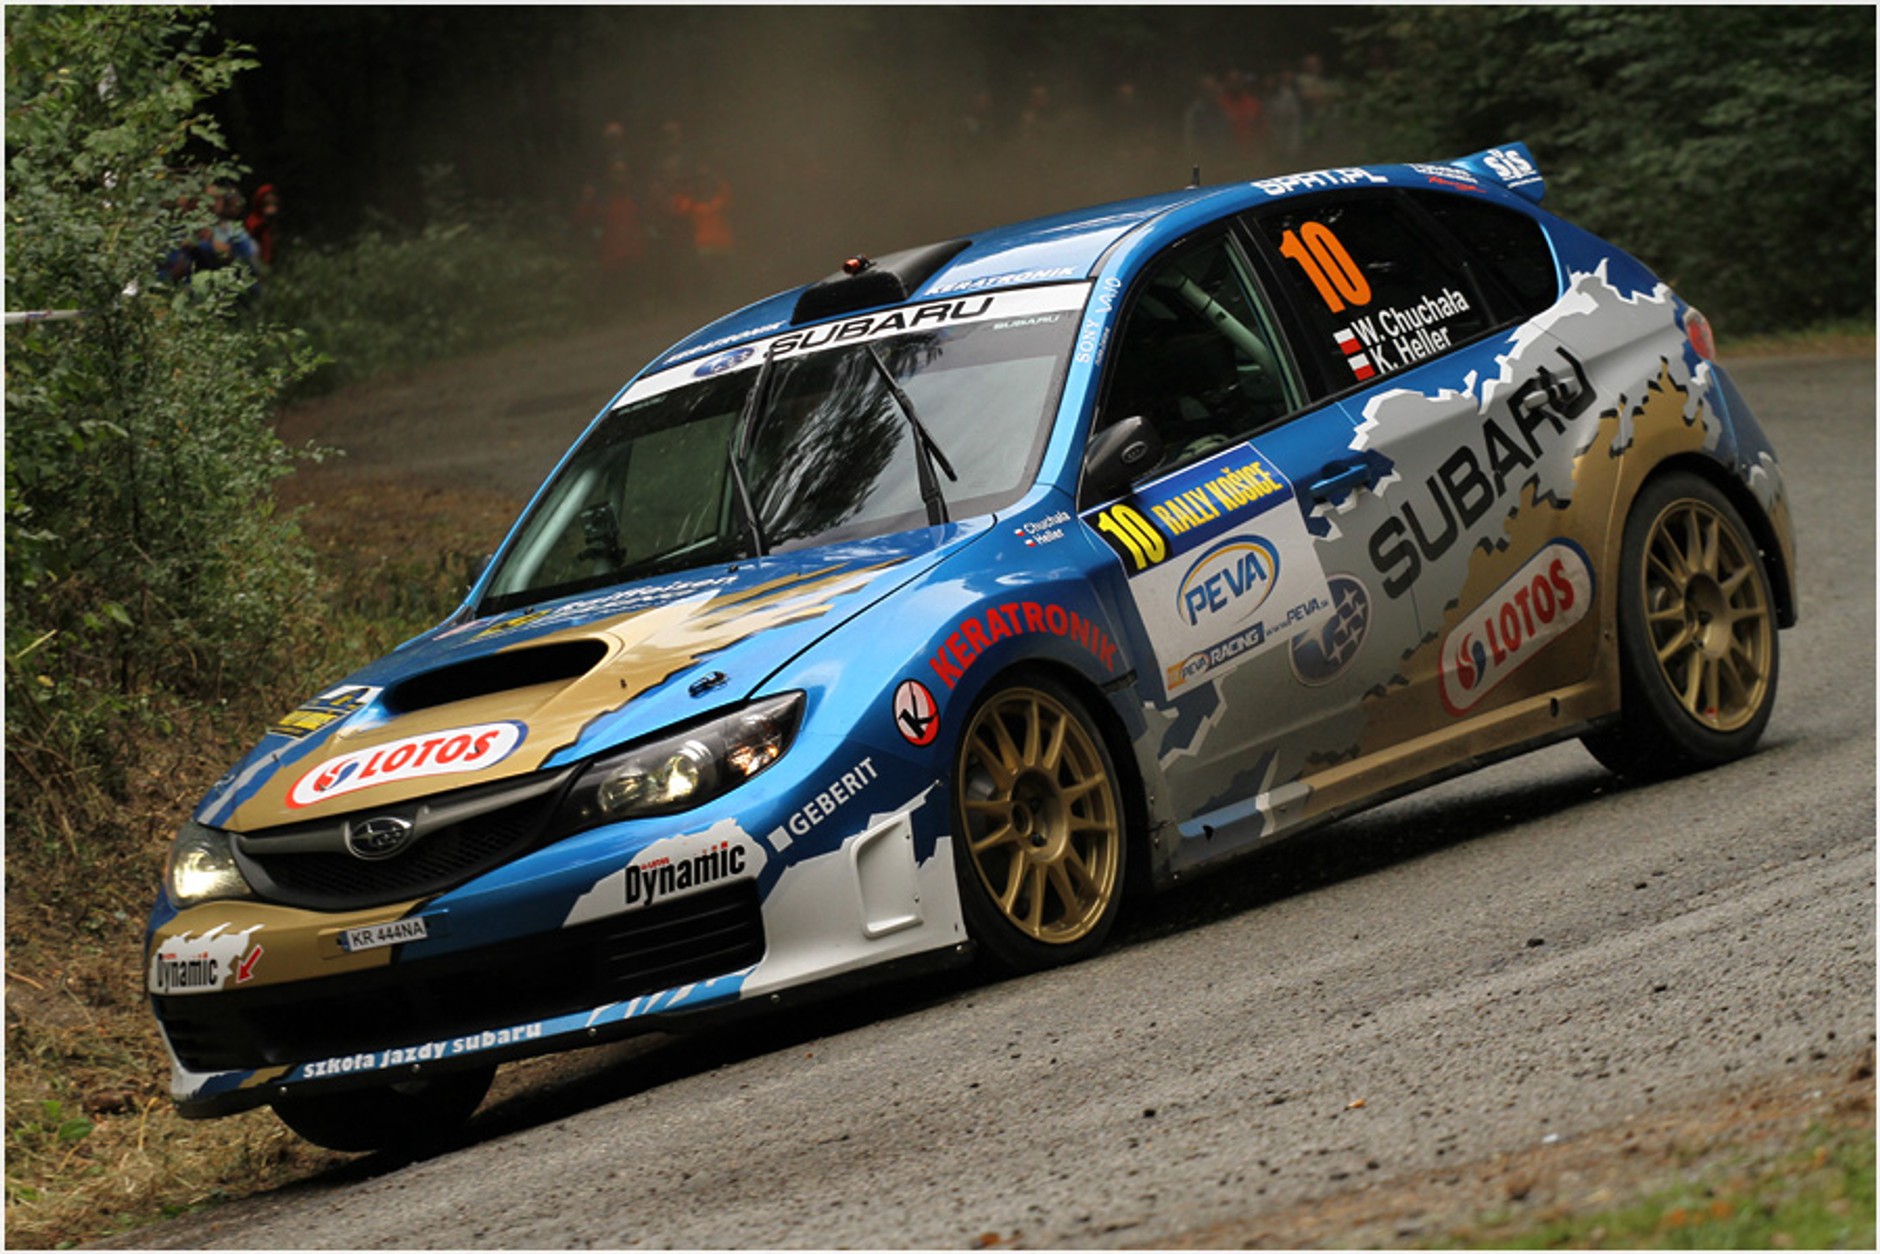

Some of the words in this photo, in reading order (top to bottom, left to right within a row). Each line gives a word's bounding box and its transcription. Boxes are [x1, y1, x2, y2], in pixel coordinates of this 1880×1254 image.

[1279, 221, 1371, 314] 10
[763, 296, 994, 360] SUBARU
[1077, 318, 1100, 364] SONY
[1350, 315, 1386, 347] W.
[1369, 345, 1400, 375] K.
[1393, 326, 1452, 365] Heller
[1151, 487, 1221, 536] RALLY
[1203, 460, 1284, 511] KOŠICE
[1368, 346, 1597, 599] SUBARU
[1031, 528, 1065, 546] Heller
[1098, 503, 1166, 570] 10
[1183, 551, 1267, 626] PEVA
[1484, 558, 1575, 667] LOTOS
[928, 601, 1117, 691] KERATRONIK
[1182, 656, 1207, 679] PEVA
[1210, 628, 1260, 662] RACING
[357, 728, 501, 781] LOTOS
[788, 756, 878, 836] GEBERIT
[625, 841, 746, 906] Dynamic
[350, 930, 375, 947] KR
[378, 921, 424, 942] 444NA
[156, 951, 218, 994] Dynamic
[388, 1040, 448, 1067] jazdy
[451, 1022, 543, 1054] subaru
